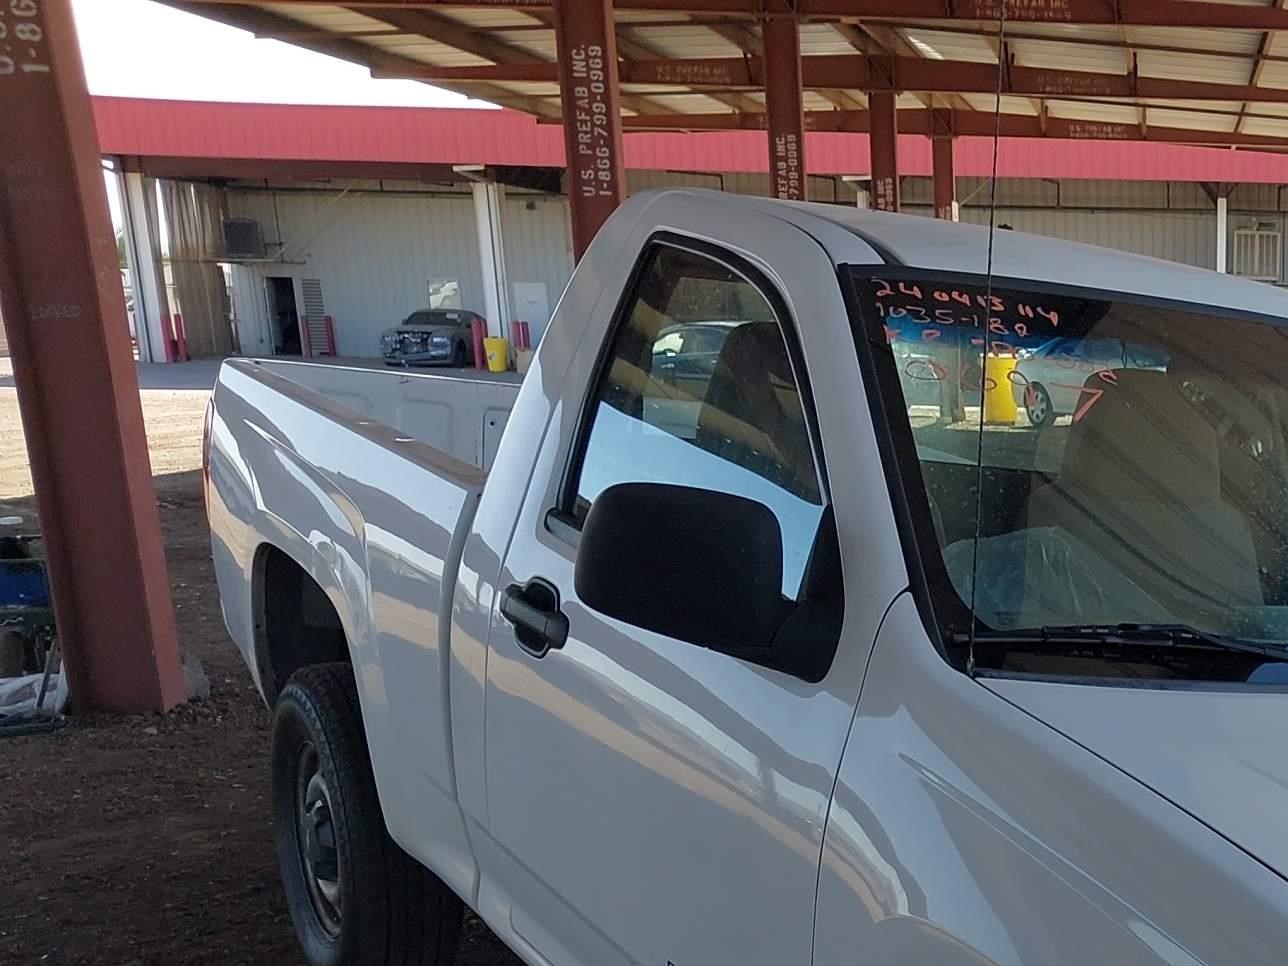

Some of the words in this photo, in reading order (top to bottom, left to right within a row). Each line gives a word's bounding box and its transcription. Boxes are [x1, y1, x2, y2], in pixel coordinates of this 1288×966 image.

[571, 44, 588, 78] INC.
[574, 86, 594, 155] PREFAB
[588, 45, 613, 196] 1-866-799-0969
[581, 165, 597, 197] U.S.
[777, 161, 789, 199] REFAB
